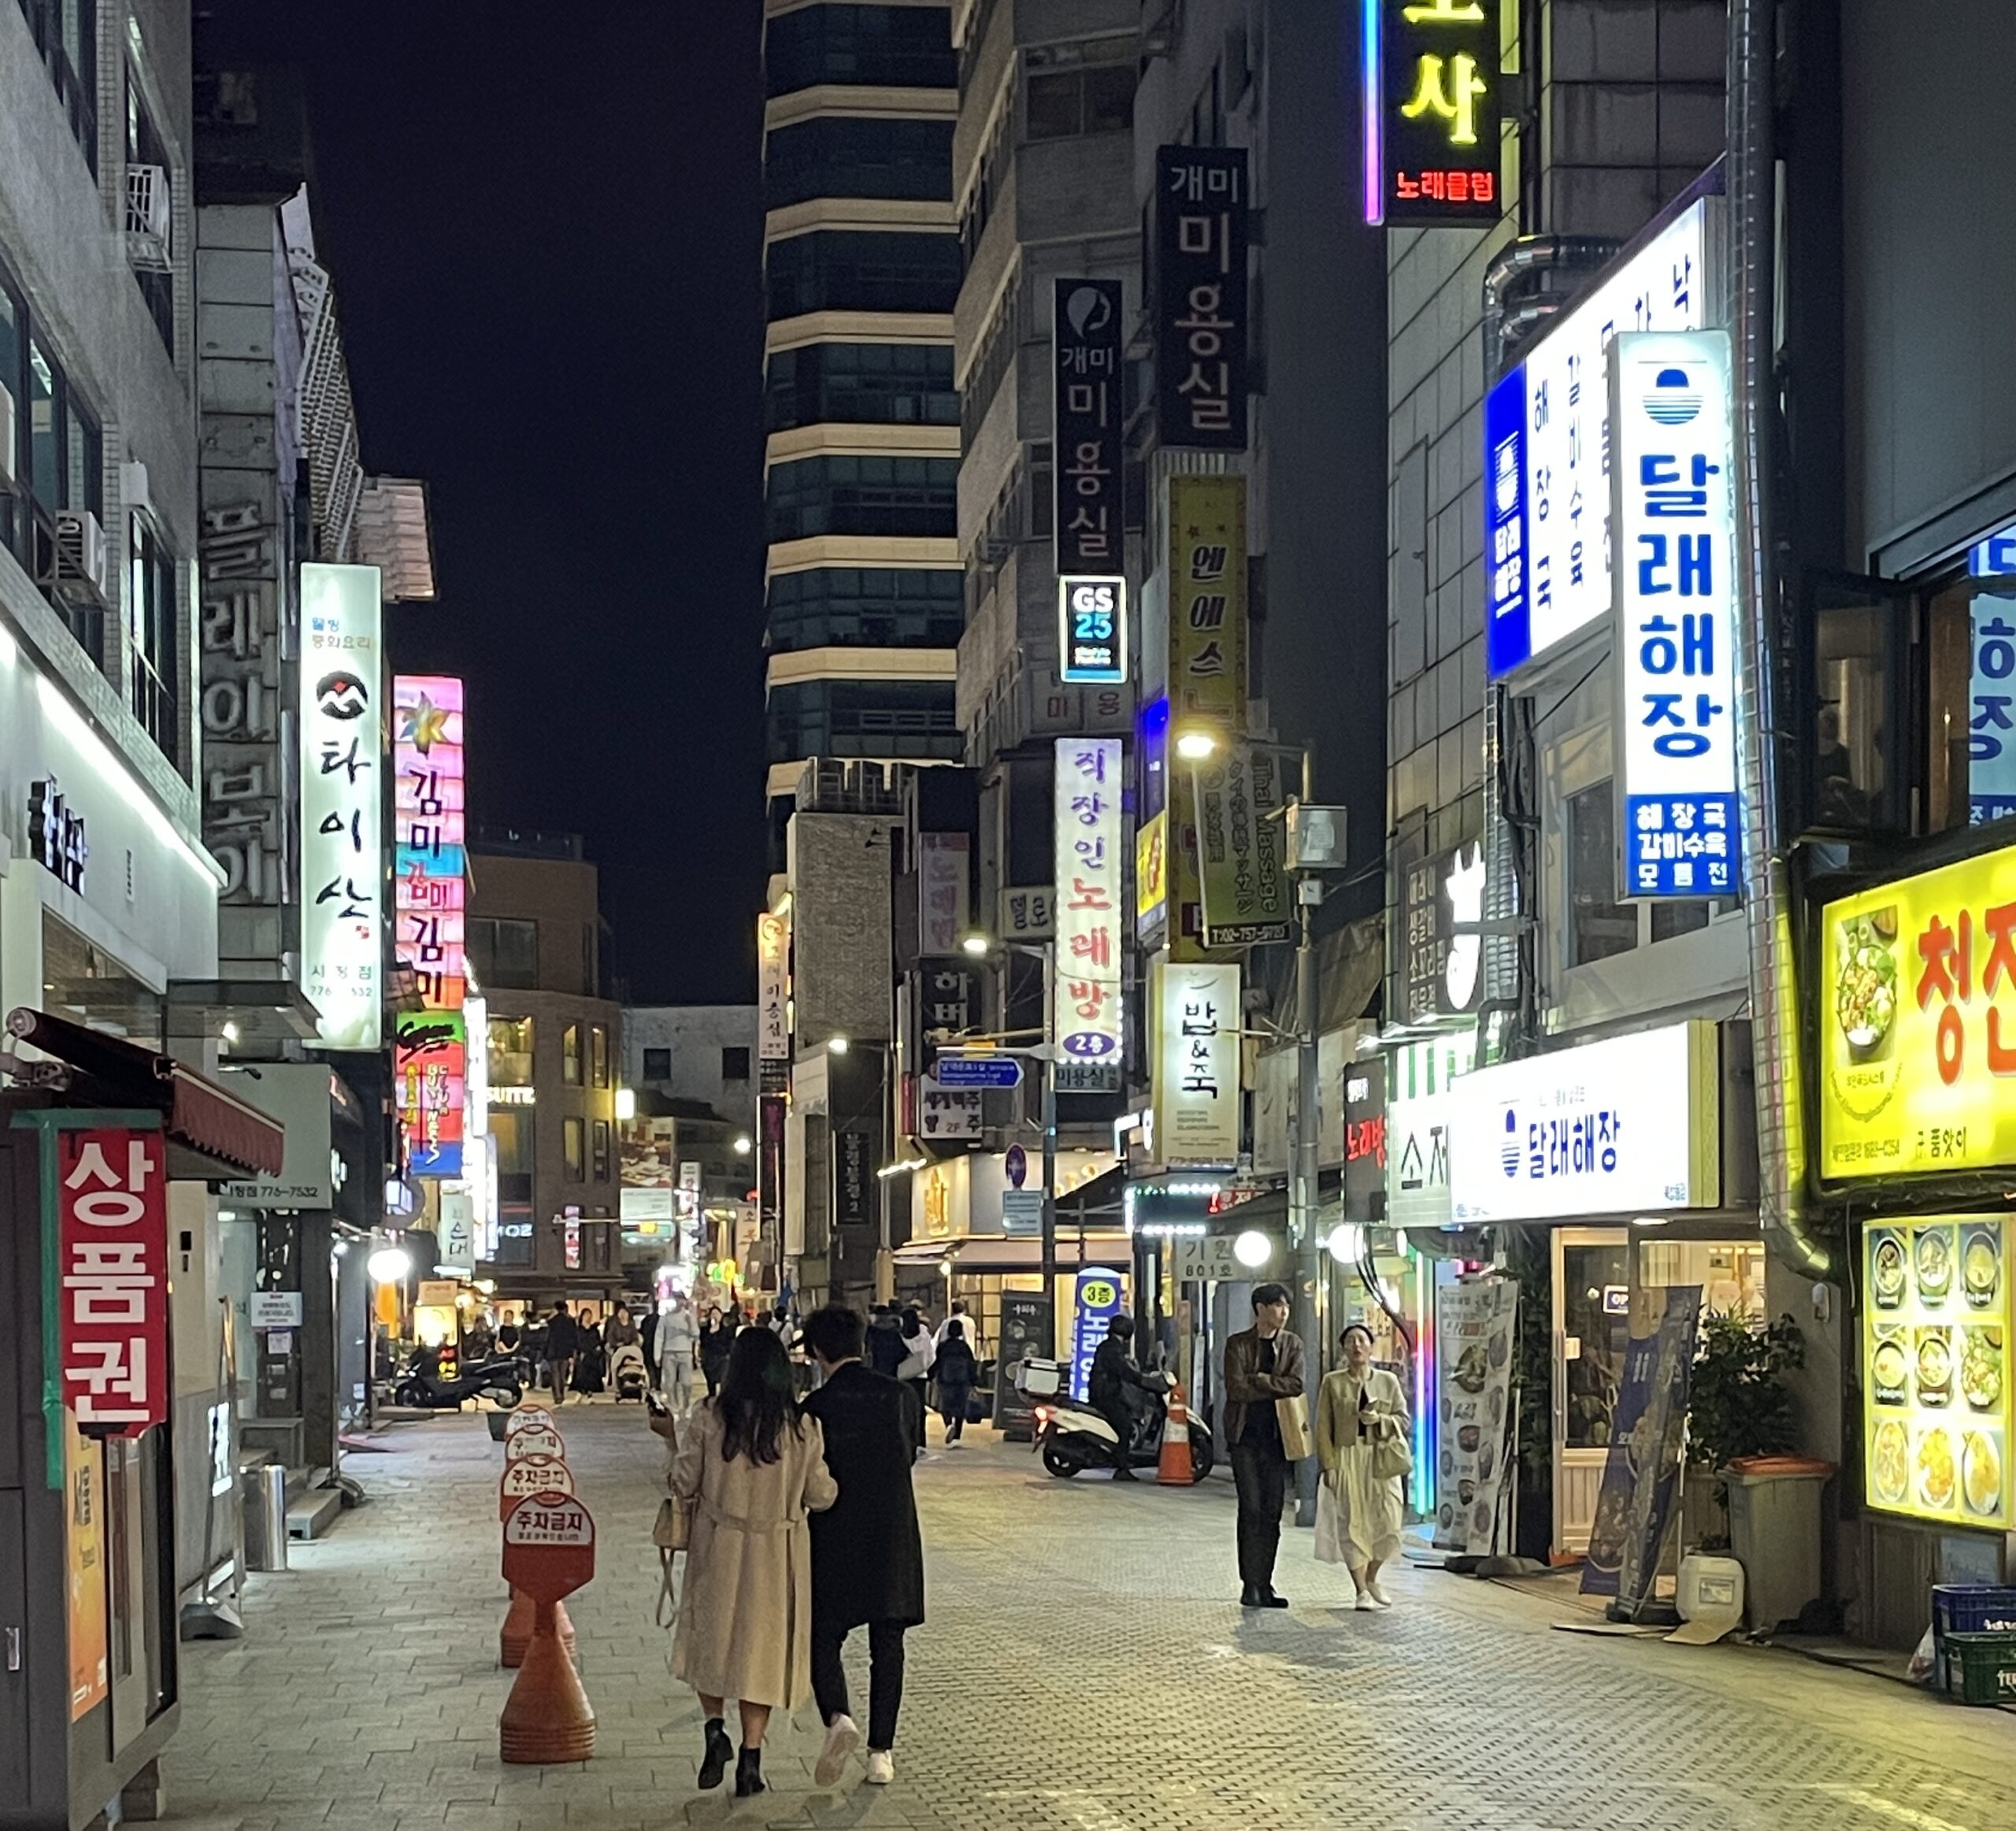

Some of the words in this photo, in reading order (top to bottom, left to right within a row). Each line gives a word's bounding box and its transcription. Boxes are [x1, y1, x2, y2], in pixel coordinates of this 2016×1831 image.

[1170, 165, 1238, 204] 개미
[1396, 171, 1493, 202] 노래클럽
[1173, 212, 1235, 430] 미용실
[1061, 346, 1114, 376] 개미
[1065, 380, 1111, 558] 미용실
[1534, 377, 1552, 610] 해장국
[1072, 586, 1114, 613] GS
[1075, 612, 1113, 639] 25
[1638, 453, 1724, 758] 달래해장
[408, 769, 443, 859] 김미
[1070, 748, 1109, 869] 직장인
[1254, 757, 1274, 809] Thai
[314, 736, 372, 919] 타이산
[1255, 814, 1279, 914] Massage
[1637, 832, 1727, 860] 갈비수육
[408, 915, 443, 1003] 김미
[1067, 877, 1113, 1021] 노래방
[1181, 1000, 1217, 1099] 밥&죽
[946, 1121, 962, 1133] 2F
[1347, 1114, 1386, 1169] 노래방
[1529, 1109, 1621, 1179] 달래해장
[64, 1140, 156, 1422] 상품권
[1087, 1286, 1111, 1303] 3층
[1610, 1293, 1629, 1305] OP
